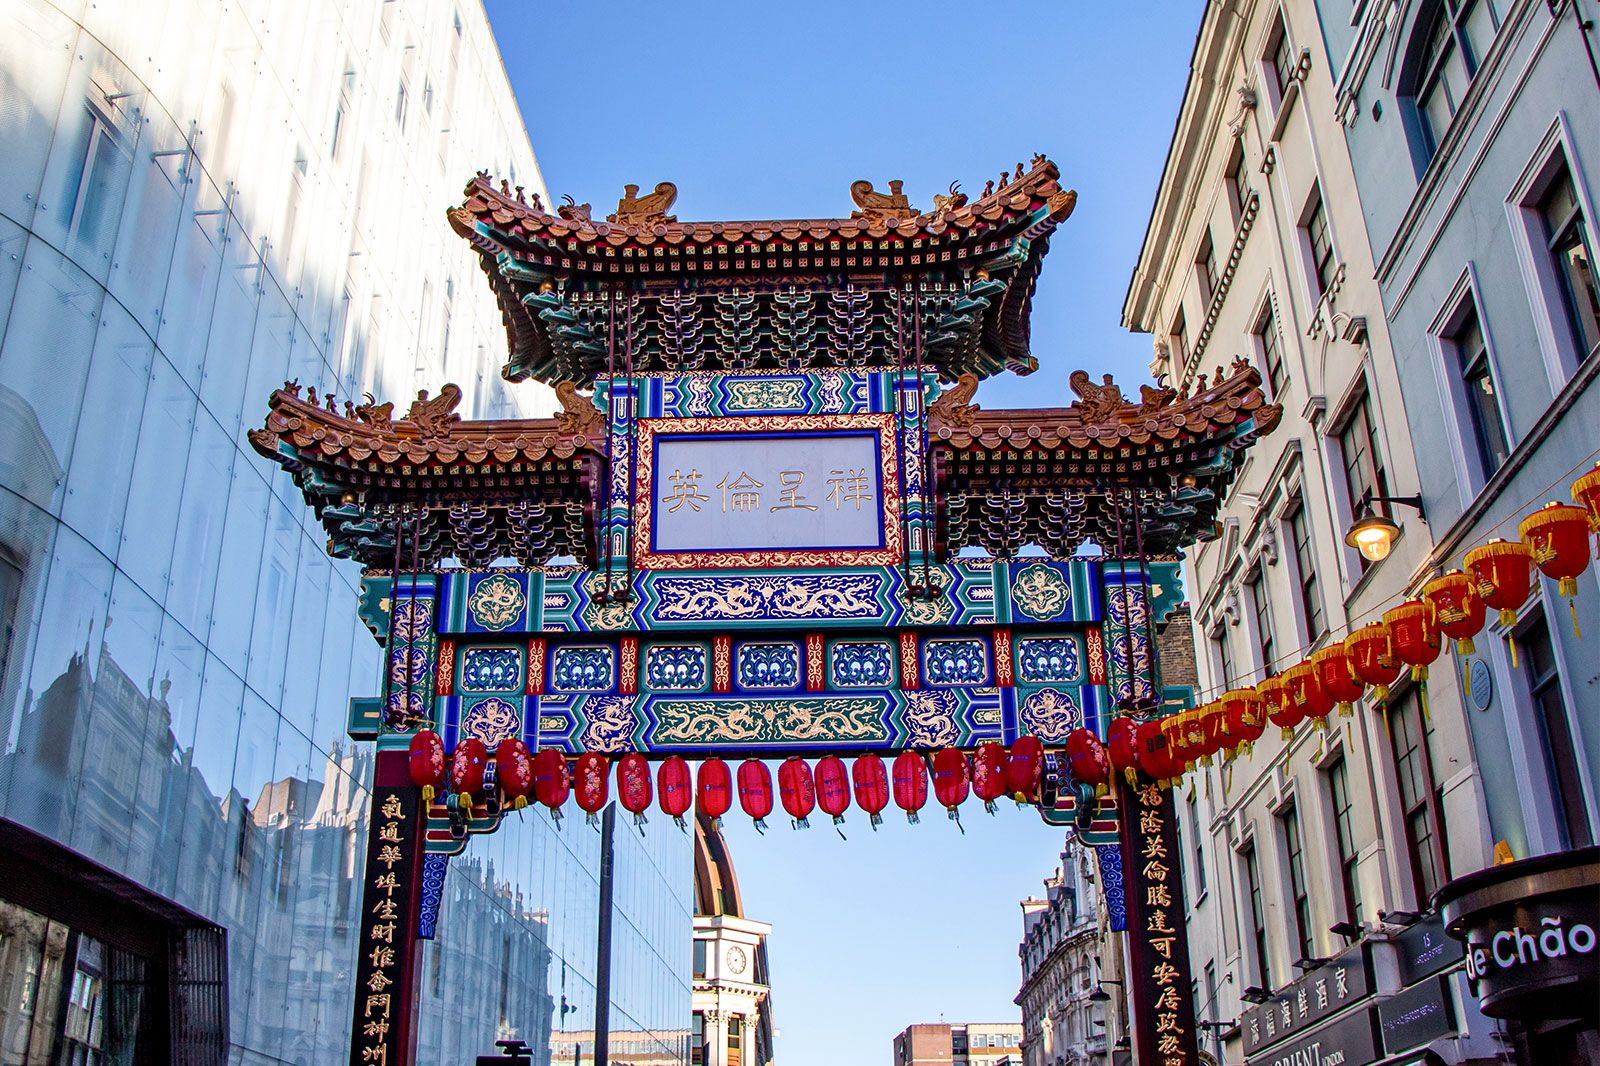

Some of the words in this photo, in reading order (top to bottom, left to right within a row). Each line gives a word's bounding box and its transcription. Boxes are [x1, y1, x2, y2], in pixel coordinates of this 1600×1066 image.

[662, 469, 873, 513] 英倫呈祥
[1465, 942, 1487, 981] de
[1492, 915, 1597, 968] Chão
